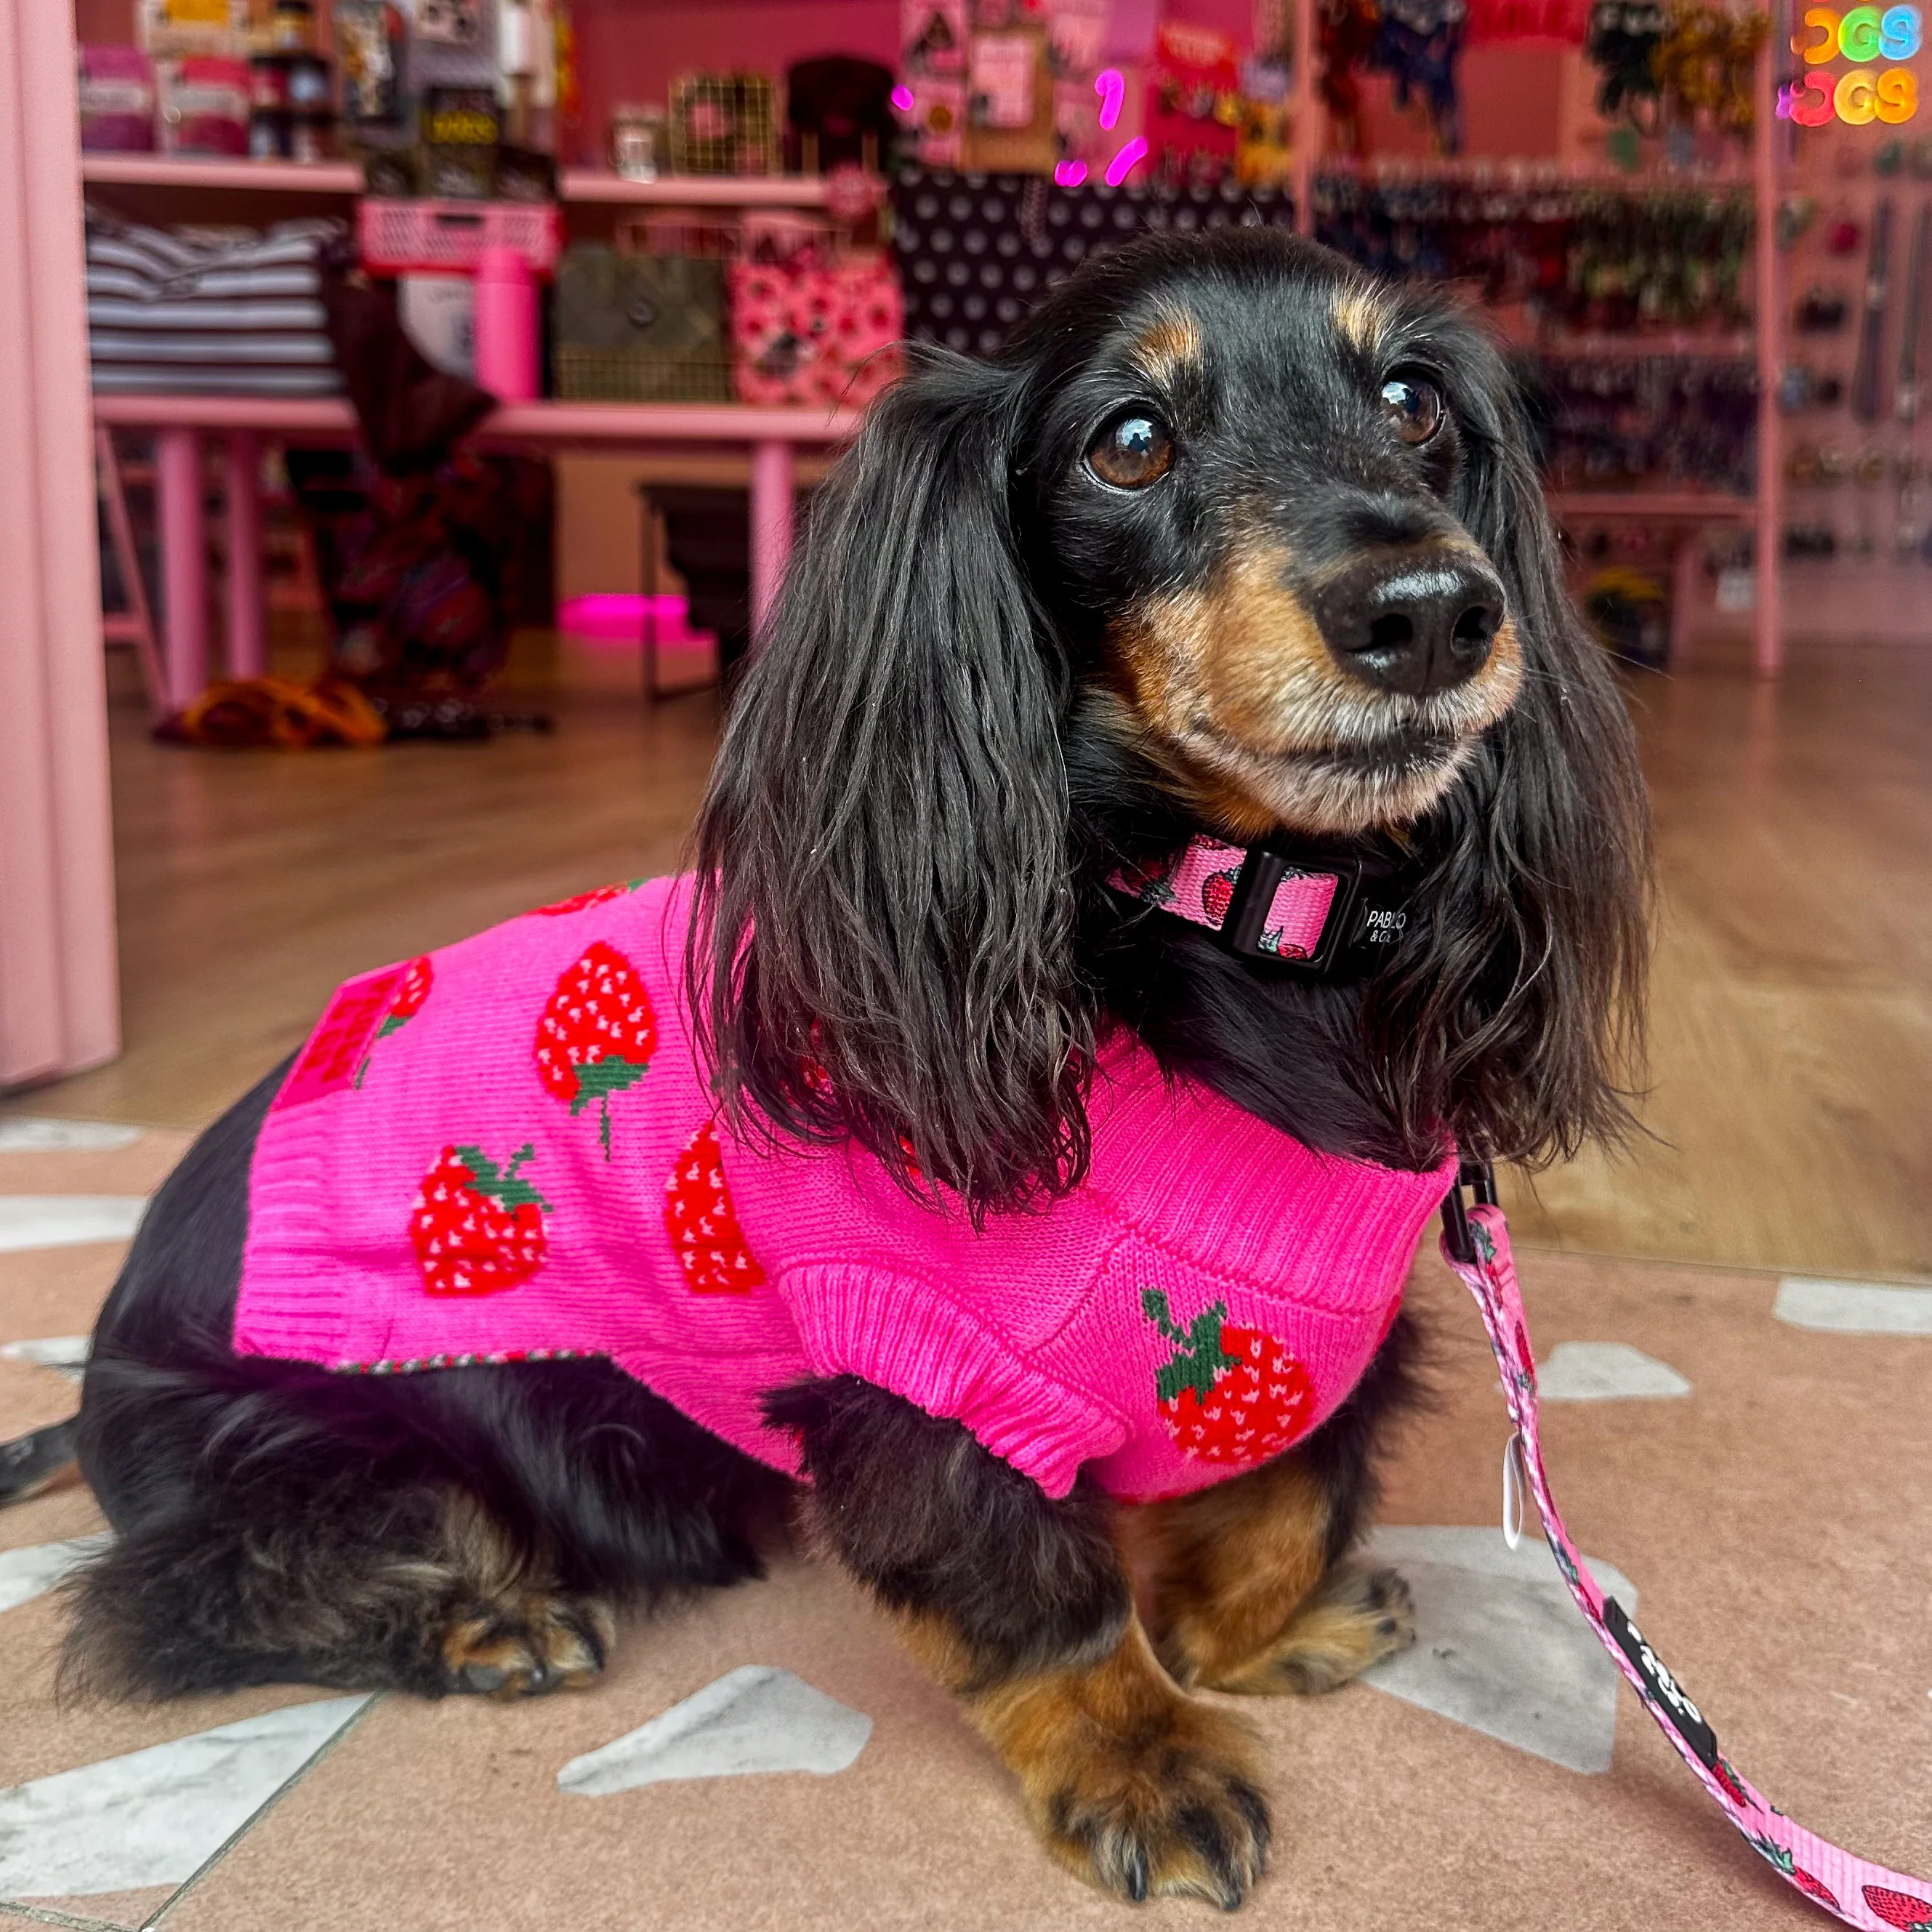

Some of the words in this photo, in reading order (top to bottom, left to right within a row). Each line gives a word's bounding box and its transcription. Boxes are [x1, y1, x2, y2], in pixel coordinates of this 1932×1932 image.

[1791, 5, 1921, 64] OGS
[1776, 68, 1917, 127] OGS
[1367, 910, 1406, 930] PABLO
